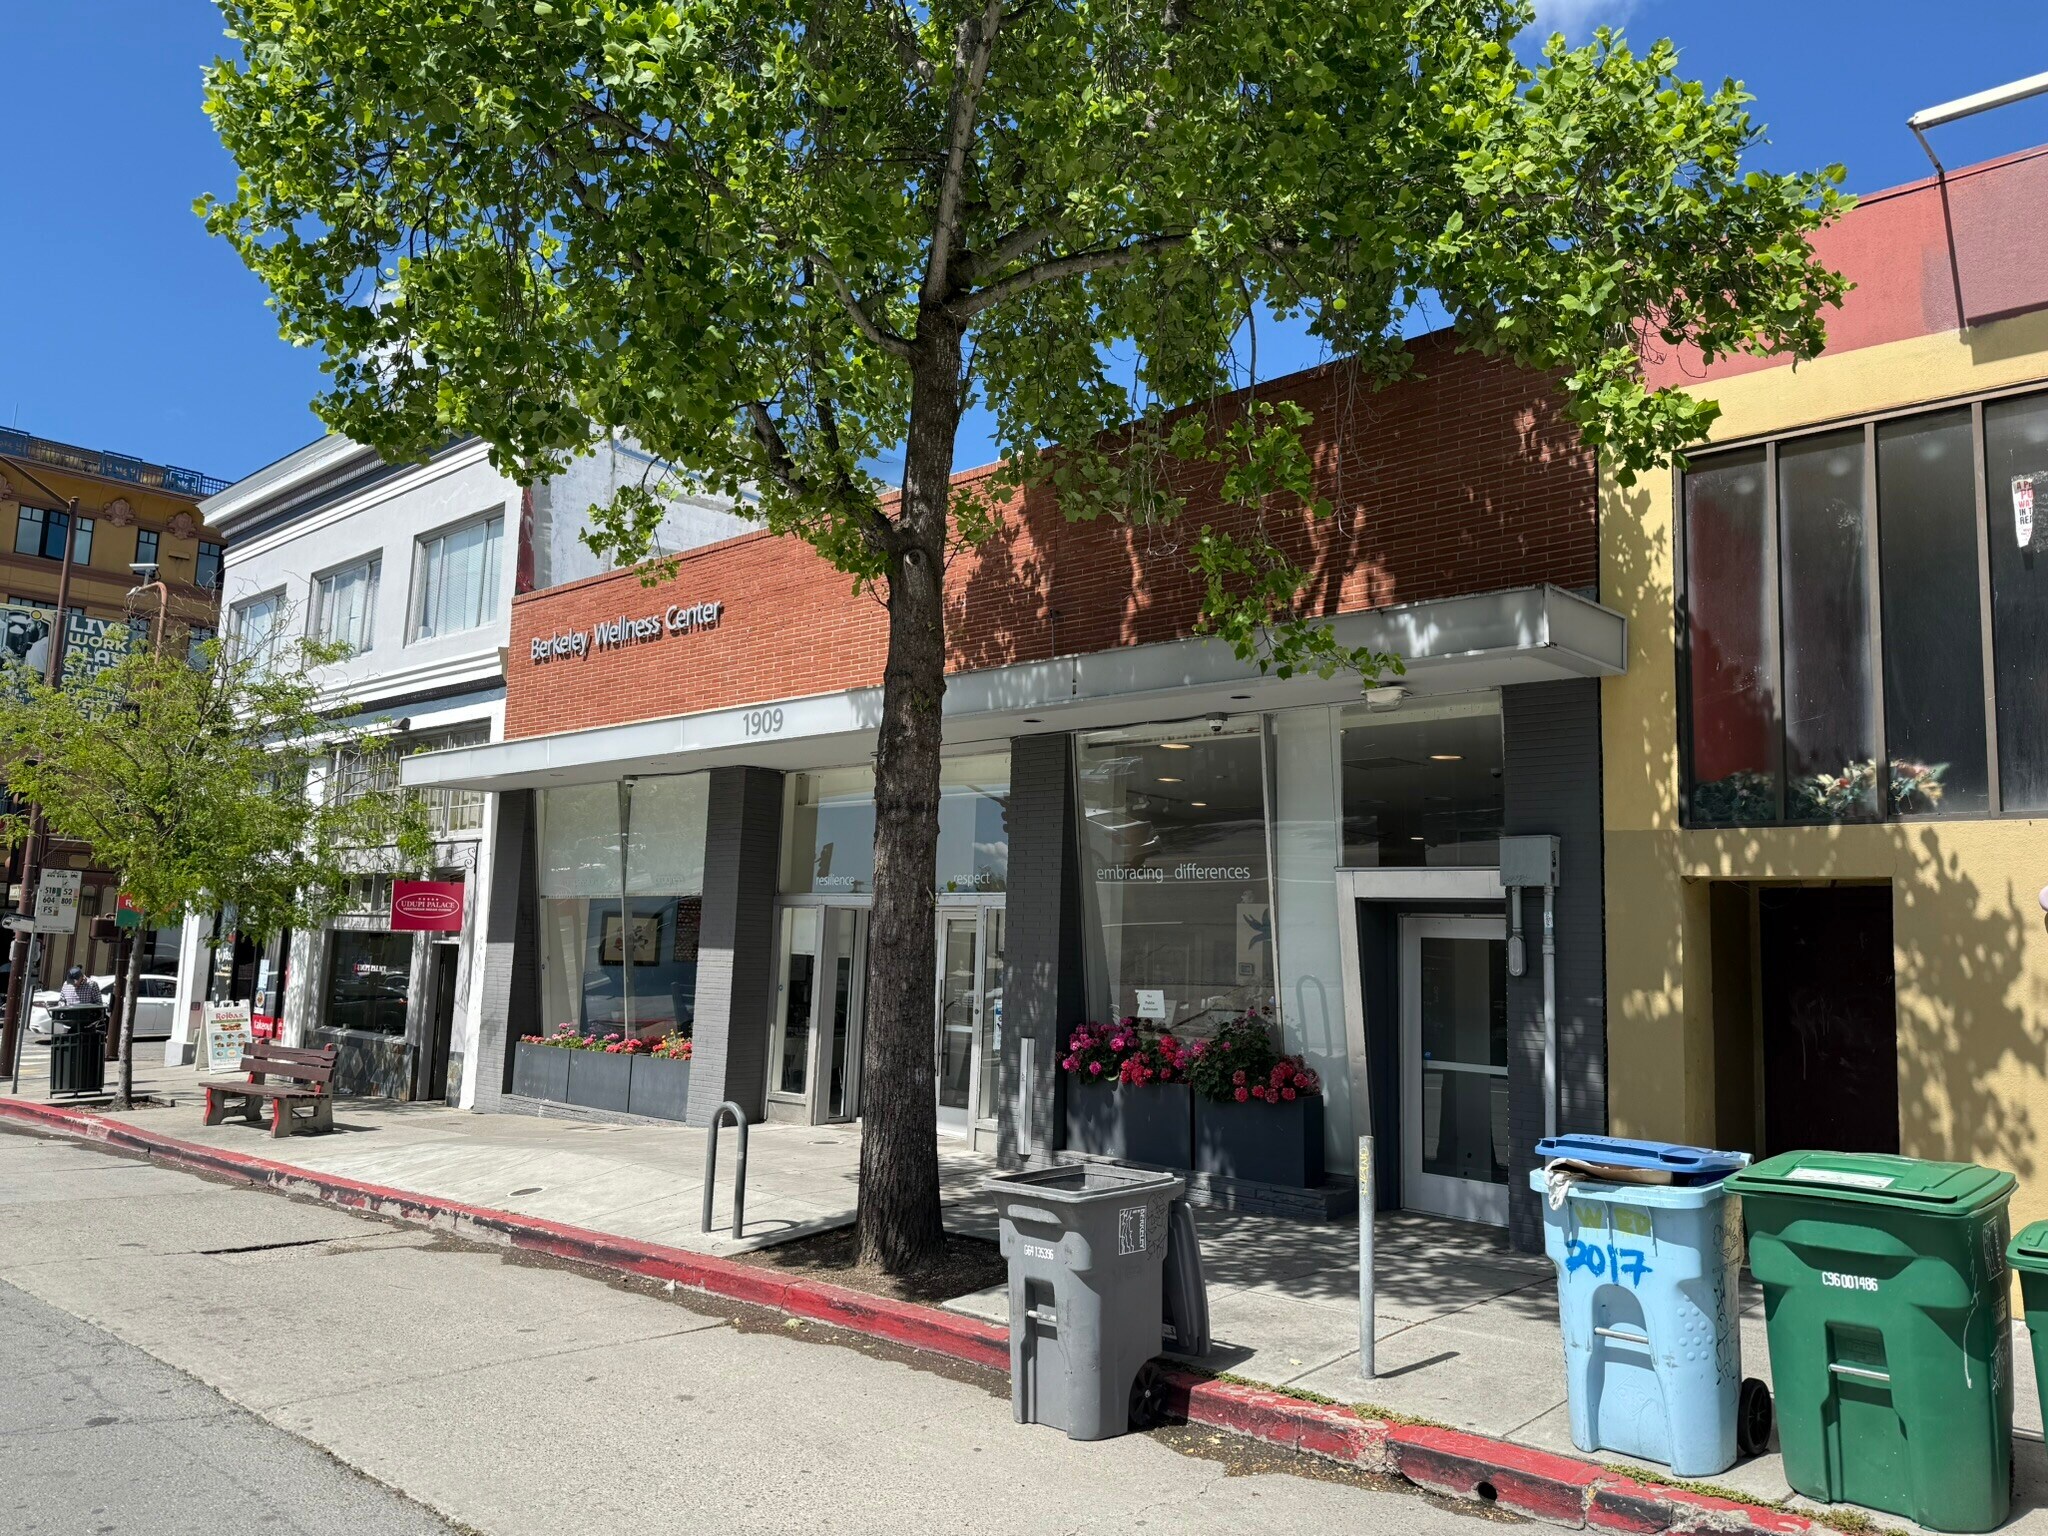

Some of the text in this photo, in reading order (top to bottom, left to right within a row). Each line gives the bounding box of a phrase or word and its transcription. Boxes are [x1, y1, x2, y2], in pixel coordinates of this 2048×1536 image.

[531, 600, 721, 659] Berkeley Wellness Center
[68, 632, 128, 651] WORK
[743, 707, 783, 736] 1909
[815, 872, 990, 887] resilience respect
[1097, 863, 1250, 884] embracing differences
[43, 896, 55, 904] 604
[401, 900, 455, 909] UDUPI PALACE
[43, 906, 52, 914] FS
[1565, 1239, 1653, 1289] 2017
